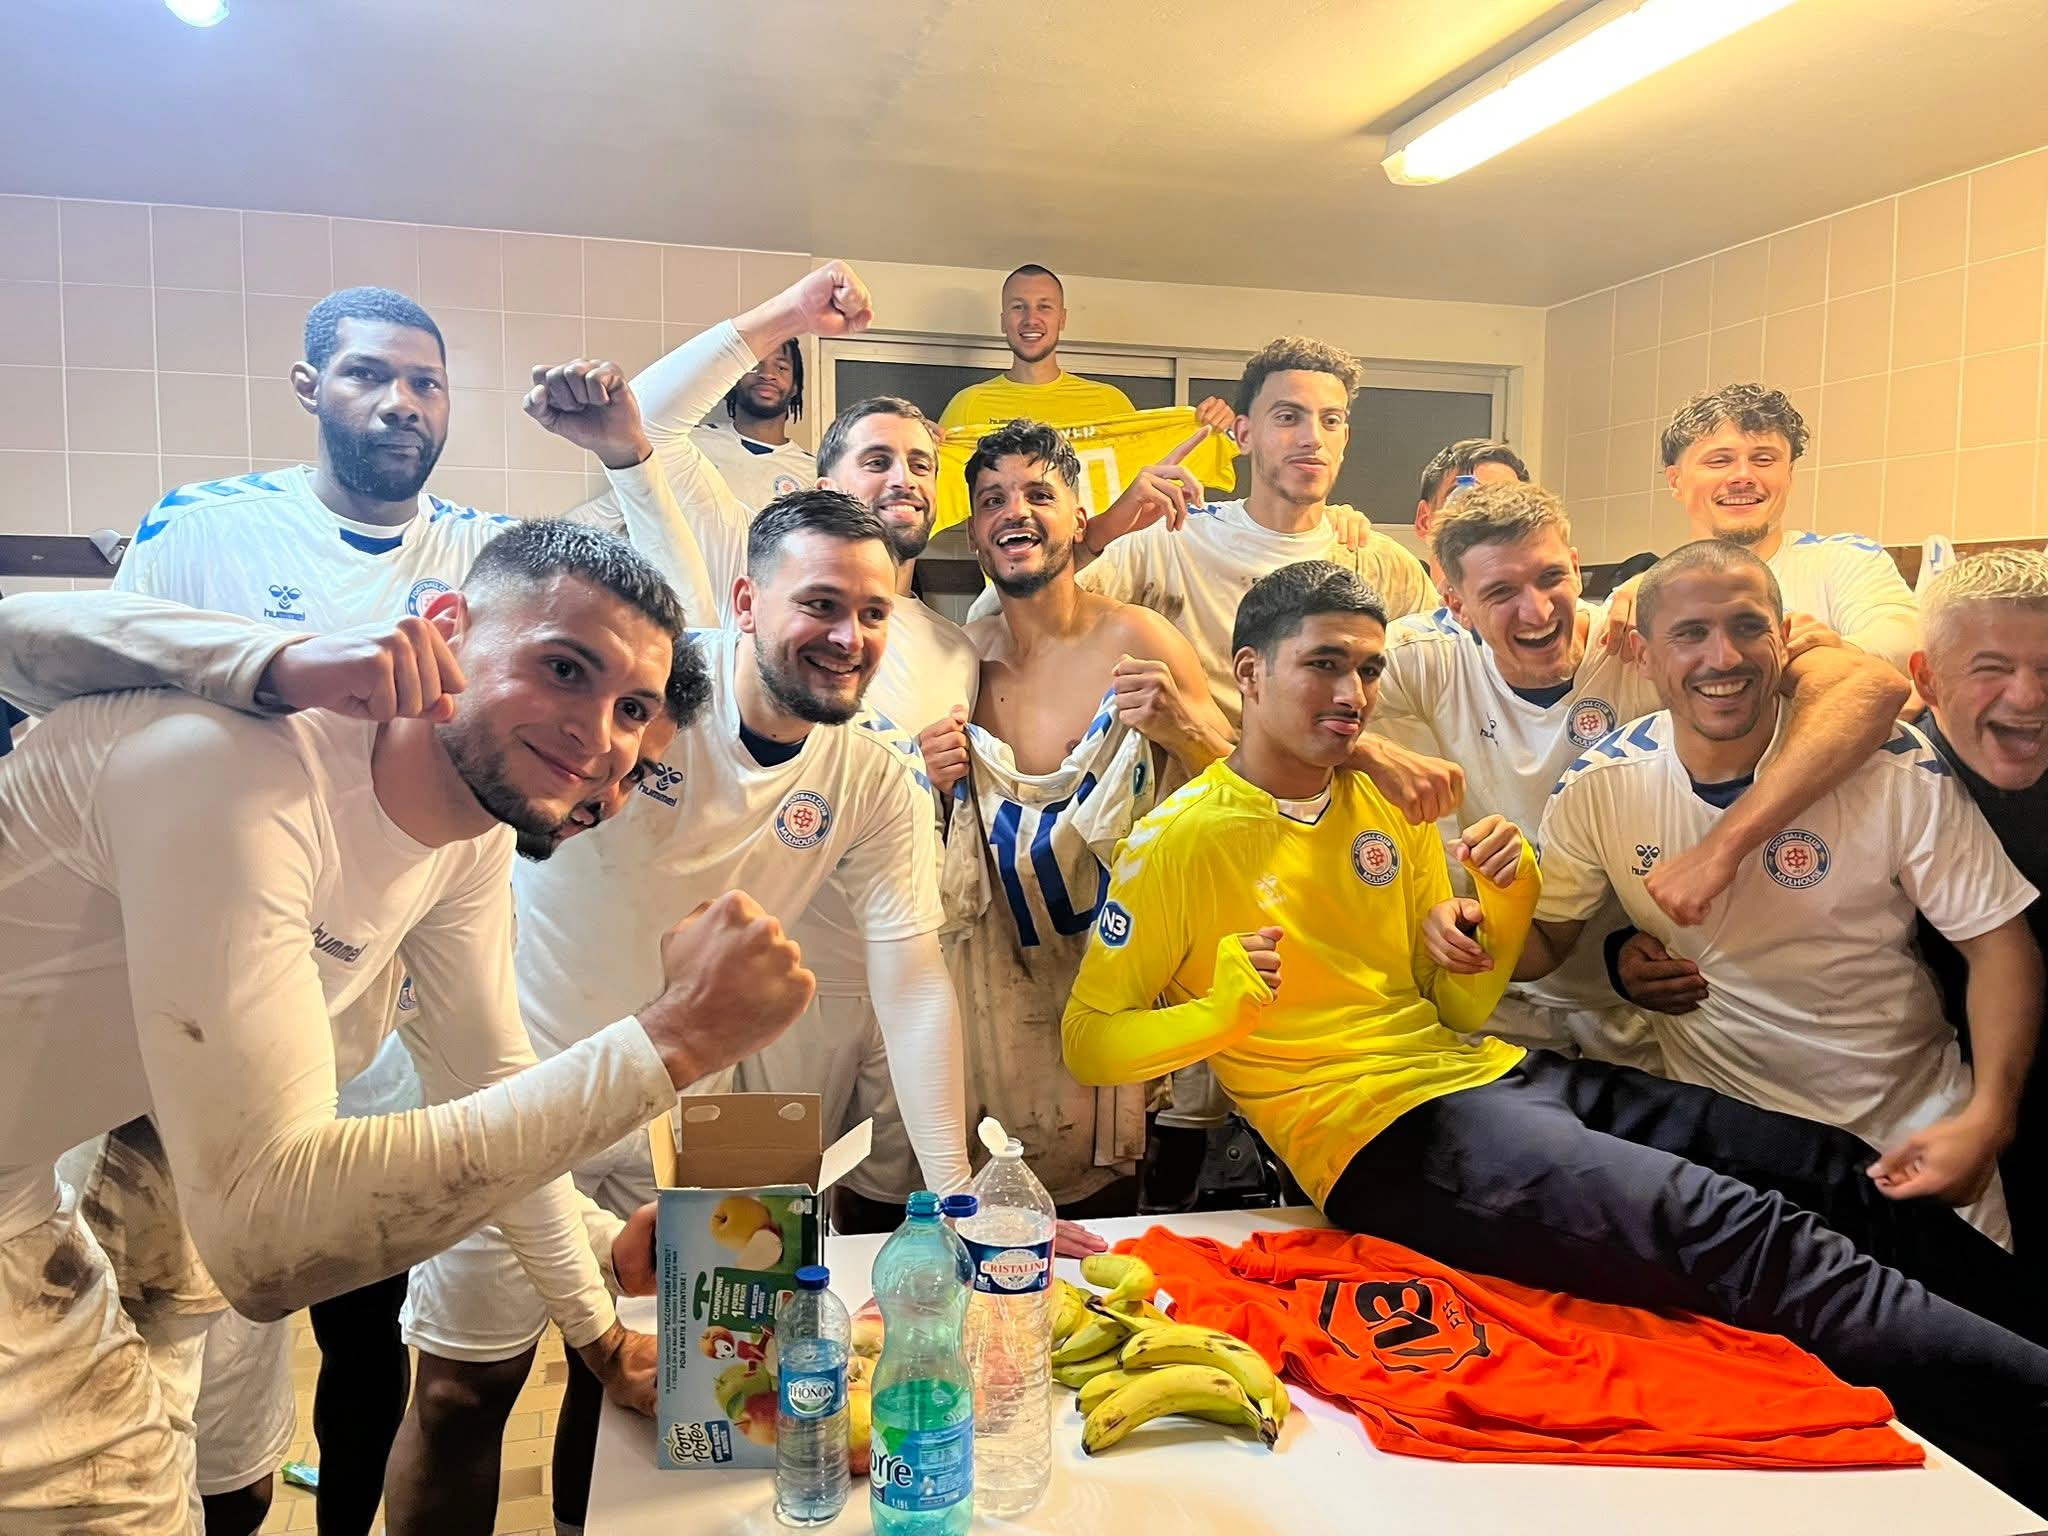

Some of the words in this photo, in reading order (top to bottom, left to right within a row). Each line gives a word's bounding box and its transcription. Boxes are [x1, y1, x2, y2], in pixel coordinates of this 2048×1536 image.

[1769, 832, 1803, 853] FOOTBALL
[1803, 834, 1822, 850] CLUB
[989, 800, 1112, 947] 10
[1774, 869, 1824, 886] MULHOUSE
[1102, 906, 1128, 934] N3
[312, 920, 368, 962] hummel
[1443, 1299, 1466, 1330] FFF
[679, 1350, 687, 1369] POUR
[674, 1423, 692, 1461] Pom'
[689, 1423, 711, 1463] Potes
[871, 1449, 912, 1486] orre
